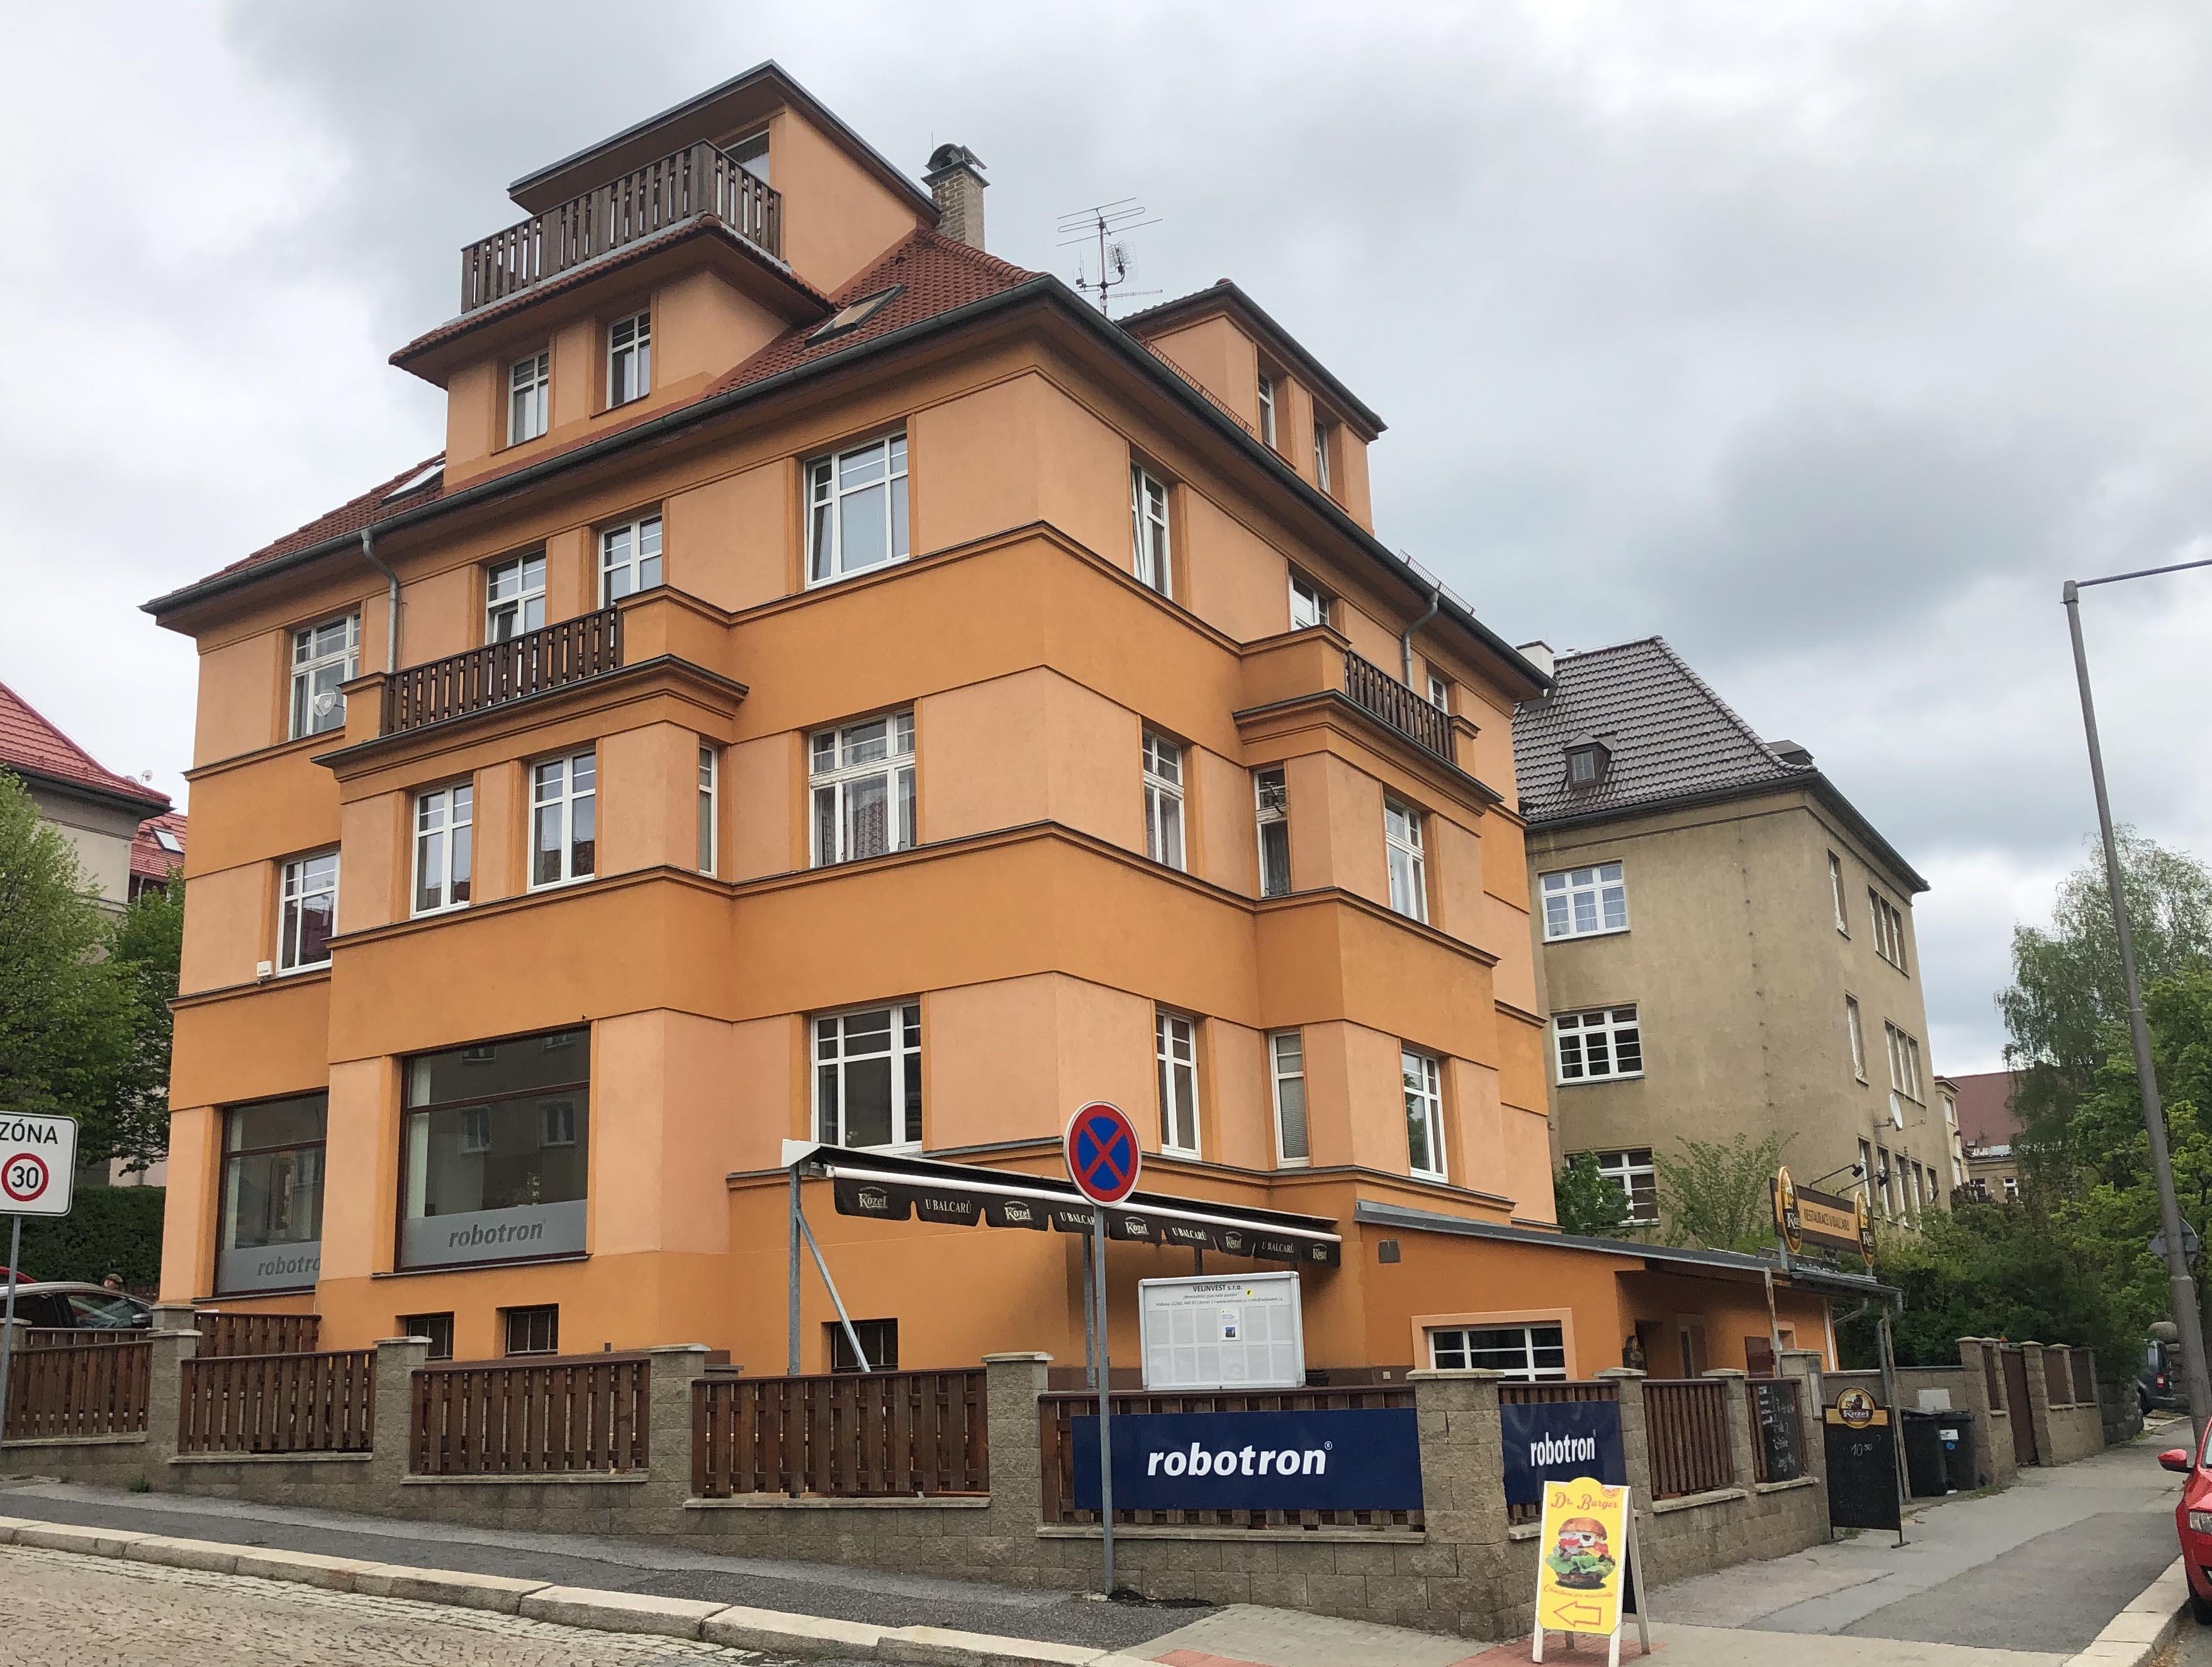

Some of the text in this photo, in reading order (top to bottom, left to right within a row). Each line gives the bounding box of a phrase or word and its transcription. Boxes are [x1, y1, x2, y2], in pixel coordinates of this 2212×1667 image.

[0, 1118, 58, 1145] ZÓNA
[11, 1165, 39, 1189] 30
[858, 1193, 888, 1209] Kozel
[925, 1199, 972, 1214] U BALCARŮ
[1004, 1206, 1033, 1221] Kozel
[1059, 1211, 1095, 1225] U BALCAR
[1125, 1221, 1149, 1235] Kozel
[1172, 1227, 1179, 1236] U
[256, 1255, 320, 1276] robotro
[1193, 1284, 1227, 1293] VELINVEST
[1843, 1410, 1870, 1419] Kozel
[1551, 1491, 1618, 1511] Dr. Burger
